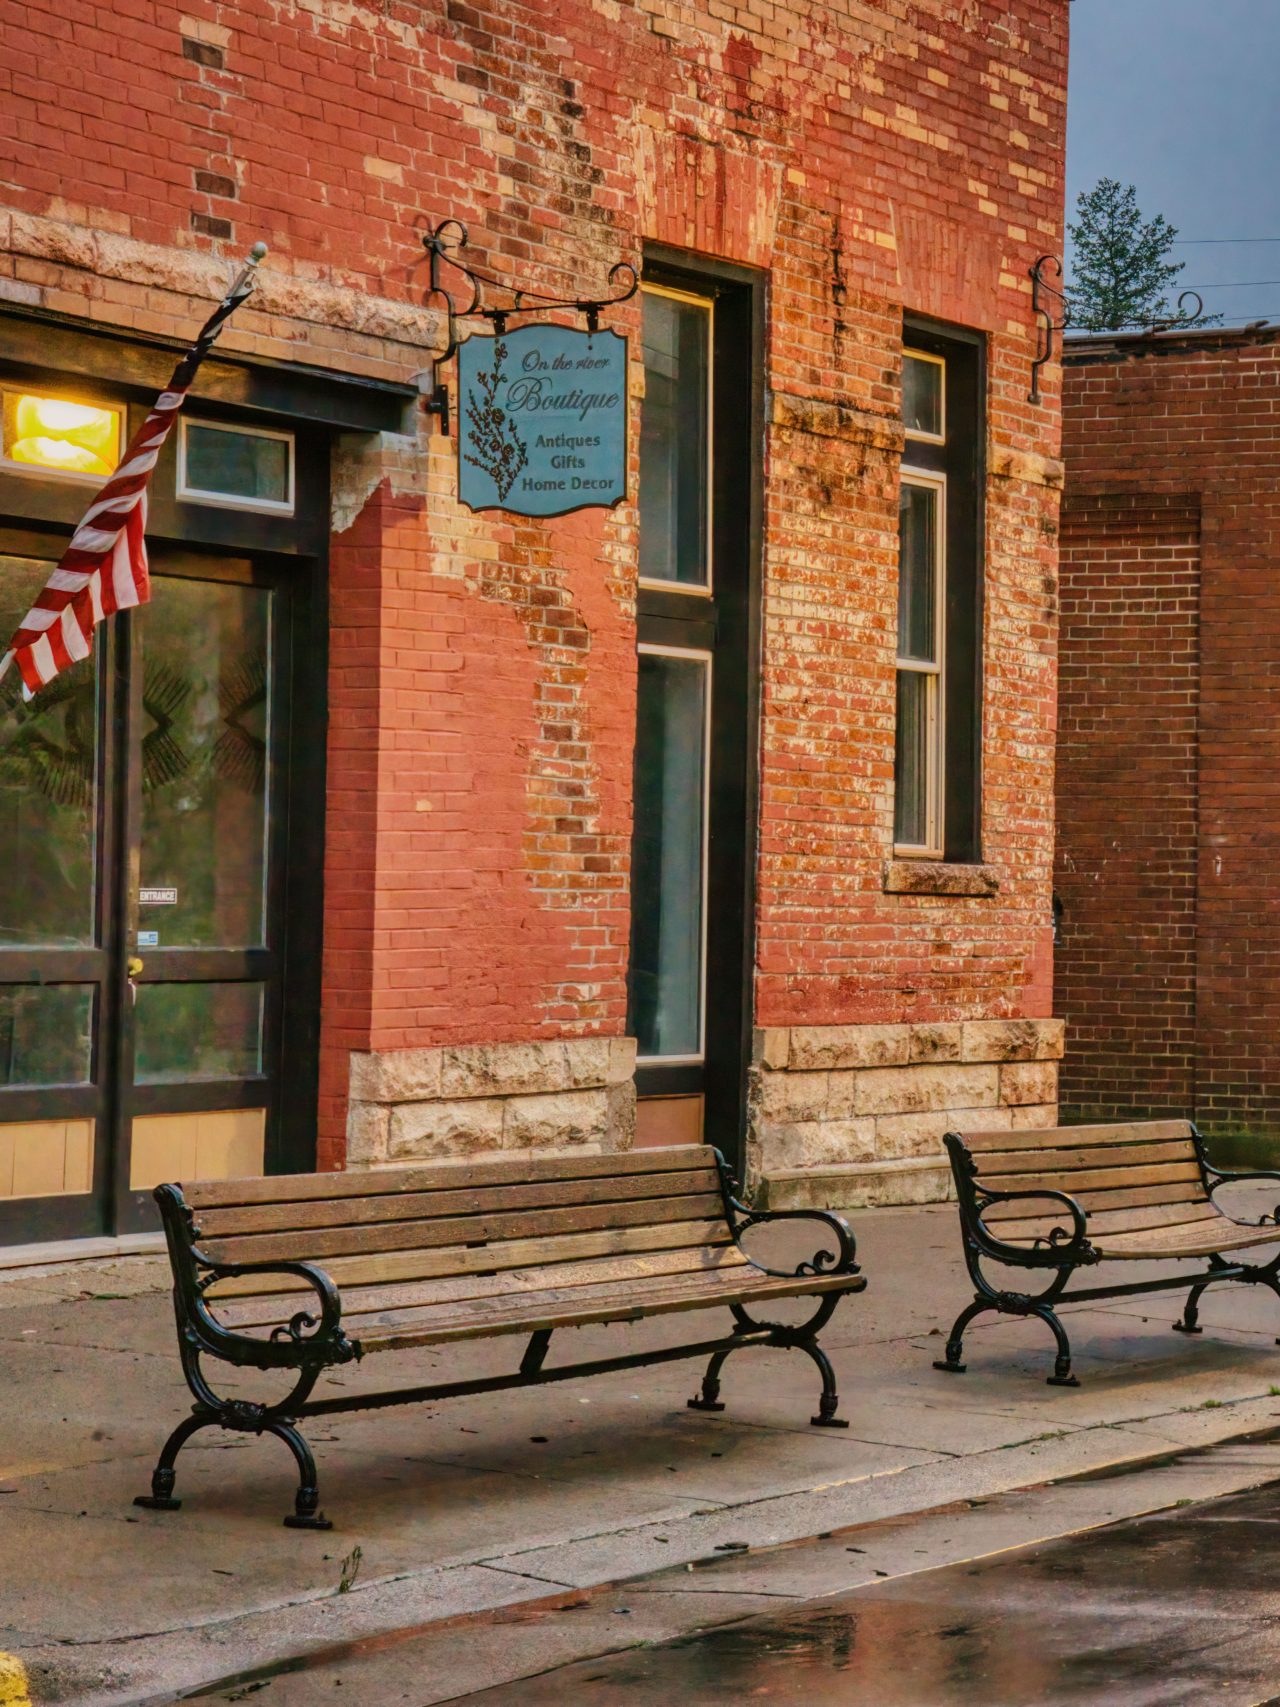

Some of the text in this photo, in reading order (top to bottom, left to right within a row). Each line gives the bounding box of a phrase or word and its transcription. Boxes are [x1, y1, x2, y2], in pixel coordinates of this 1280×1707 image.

[522, 350, 610, 372] On the river
[506, 376, 620, 422] Boutique
[535, 432, 601, 450] Antiques
[551, 455, 586, 469] Gifts
[522, 476, 615, 491] Home Decor
[140, 891, 175, 900] ENTRANCE
